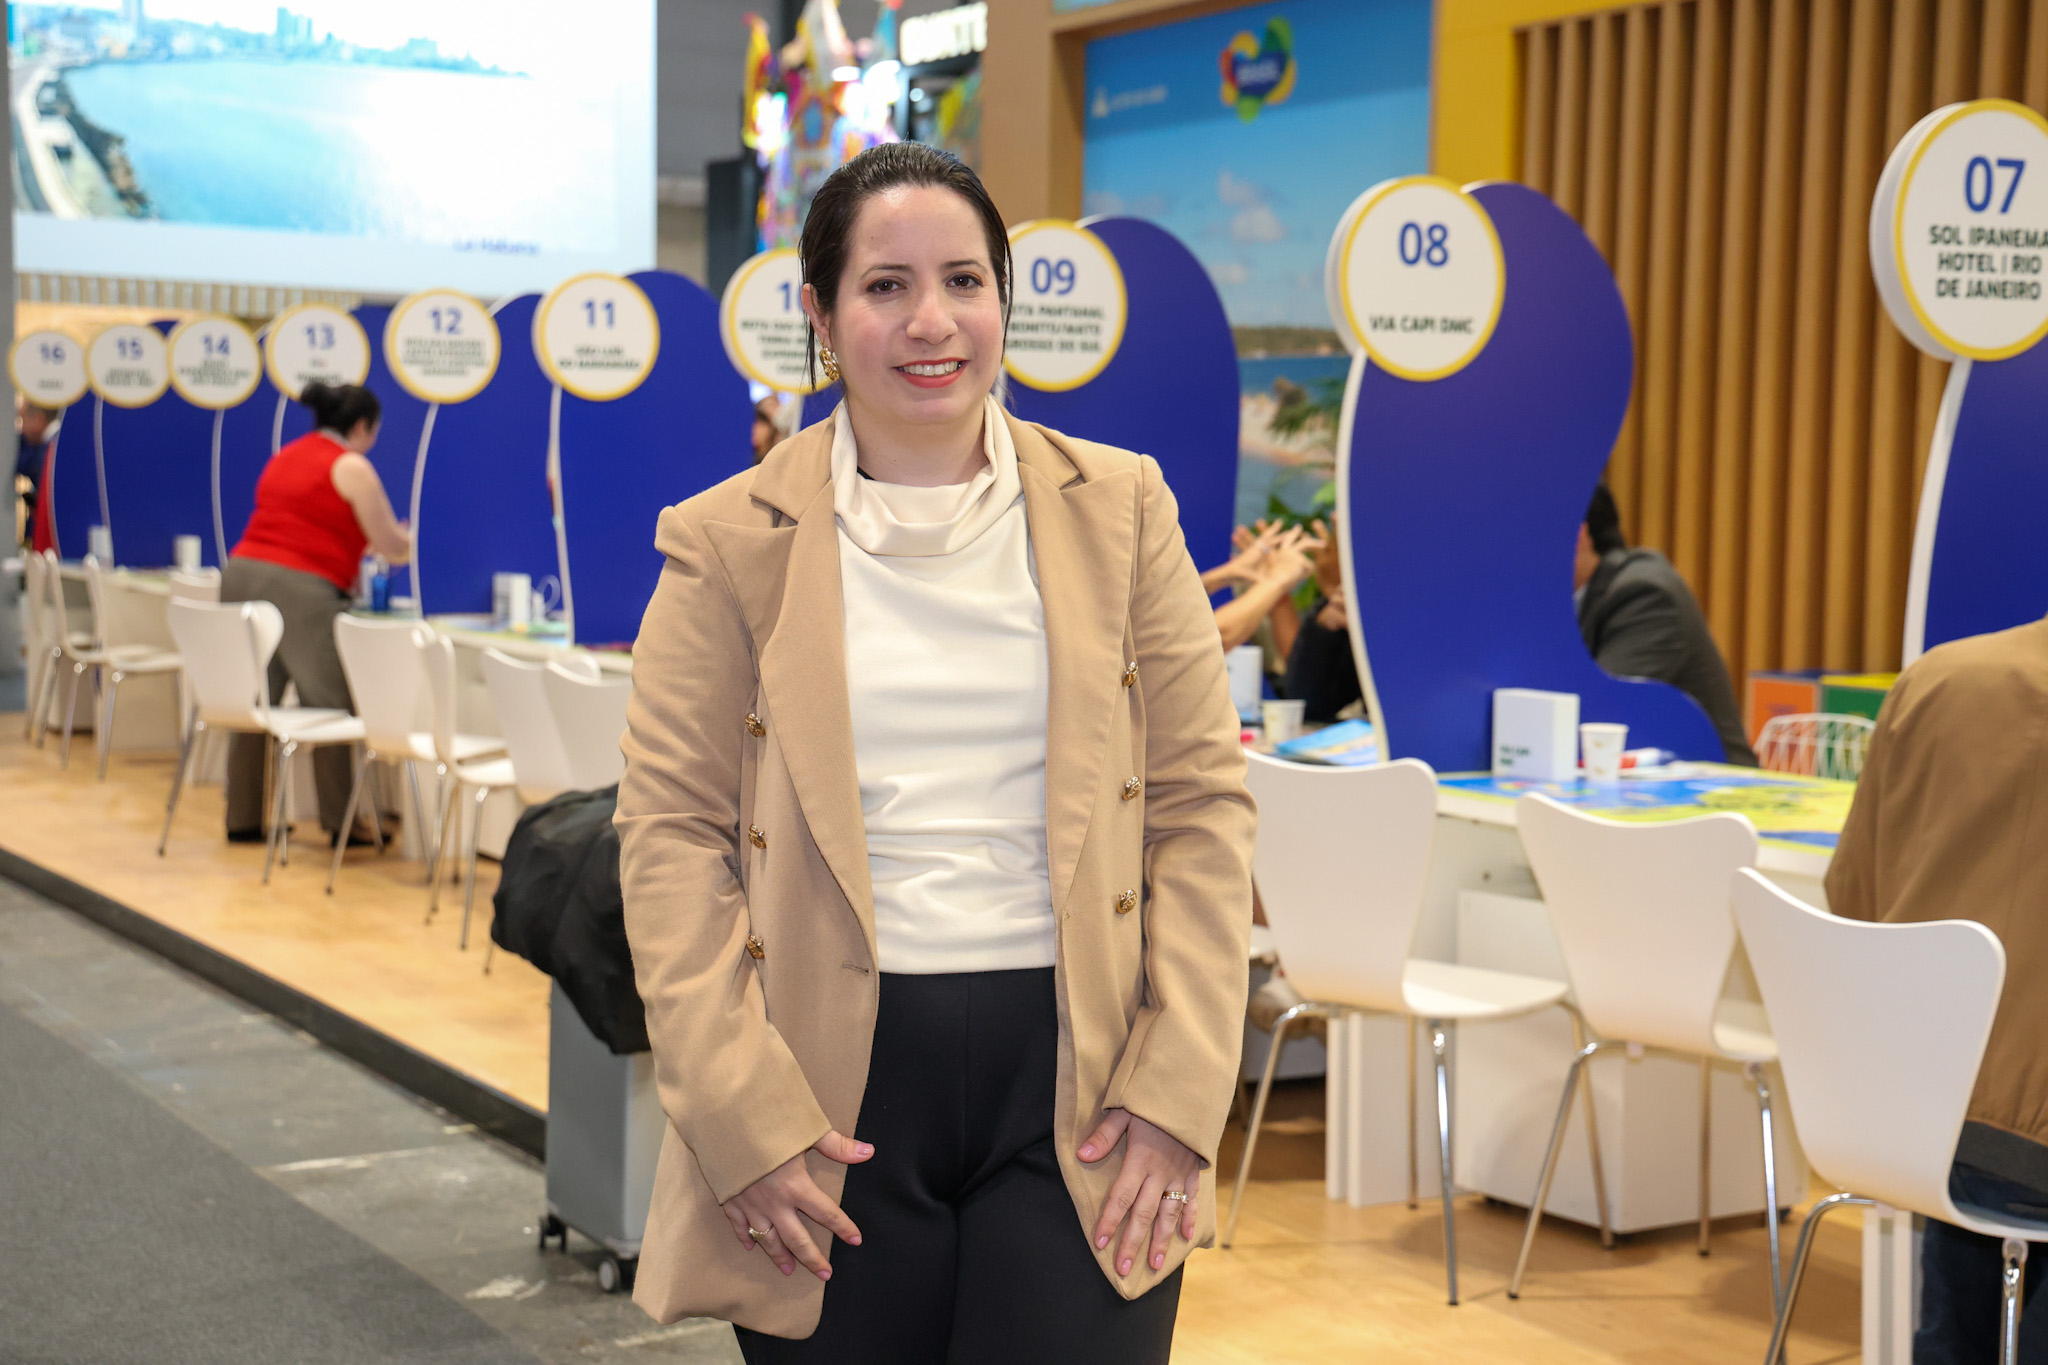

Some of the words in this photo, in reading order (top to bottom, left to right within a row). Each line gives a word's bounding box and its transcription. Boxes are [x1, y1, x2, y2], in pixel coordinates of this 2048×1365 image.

[1964, 155, 2026, 214] 07
[1399, 222, 1449, 268] 08
[1929, 225, 1963, 246] SOL
[1969, 227, 2048, 249] IPANEMA
[1937, 253, 1995, 273] HOTEL
[2011, 256, 2042, 275] RIO
[1031, 257, 1076, 296] 09
[1936, 279, 1959, 298] DE
[1965, 280, 2041, 301] JANEIRO
[430, 306, 464, 335] 12
[581, 298, 615, 328] 11
[1369, 315, 1396, 332] VIA
[1401, 316, 1434, 333] CAPI
[1440, 317, 1474, 334] DMC
[115, 336, 144, 359] 15
[200, 334, 231, 356] 14
[303, 323, 336, 349] 13
[39, 341, 66, 364] 16
